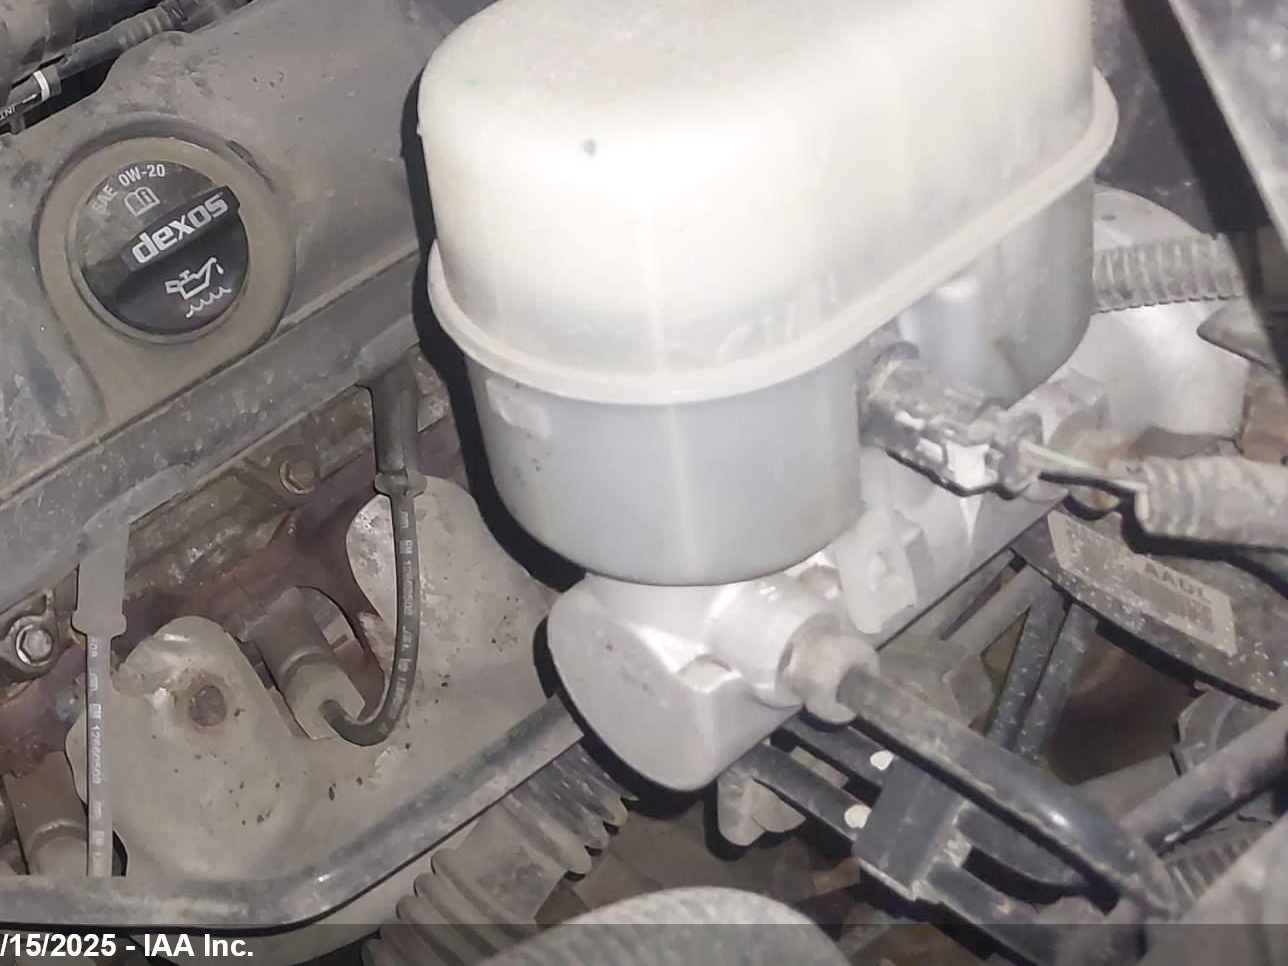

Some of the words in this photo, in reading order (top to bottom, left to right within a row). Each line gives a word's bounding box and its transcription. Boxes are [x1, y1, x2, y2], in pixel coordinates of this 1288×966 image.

[91, 185, 117, 216] SAE
[118, 163, 166, 187] 0W-20
[131, 192, 229, 264] dexos
